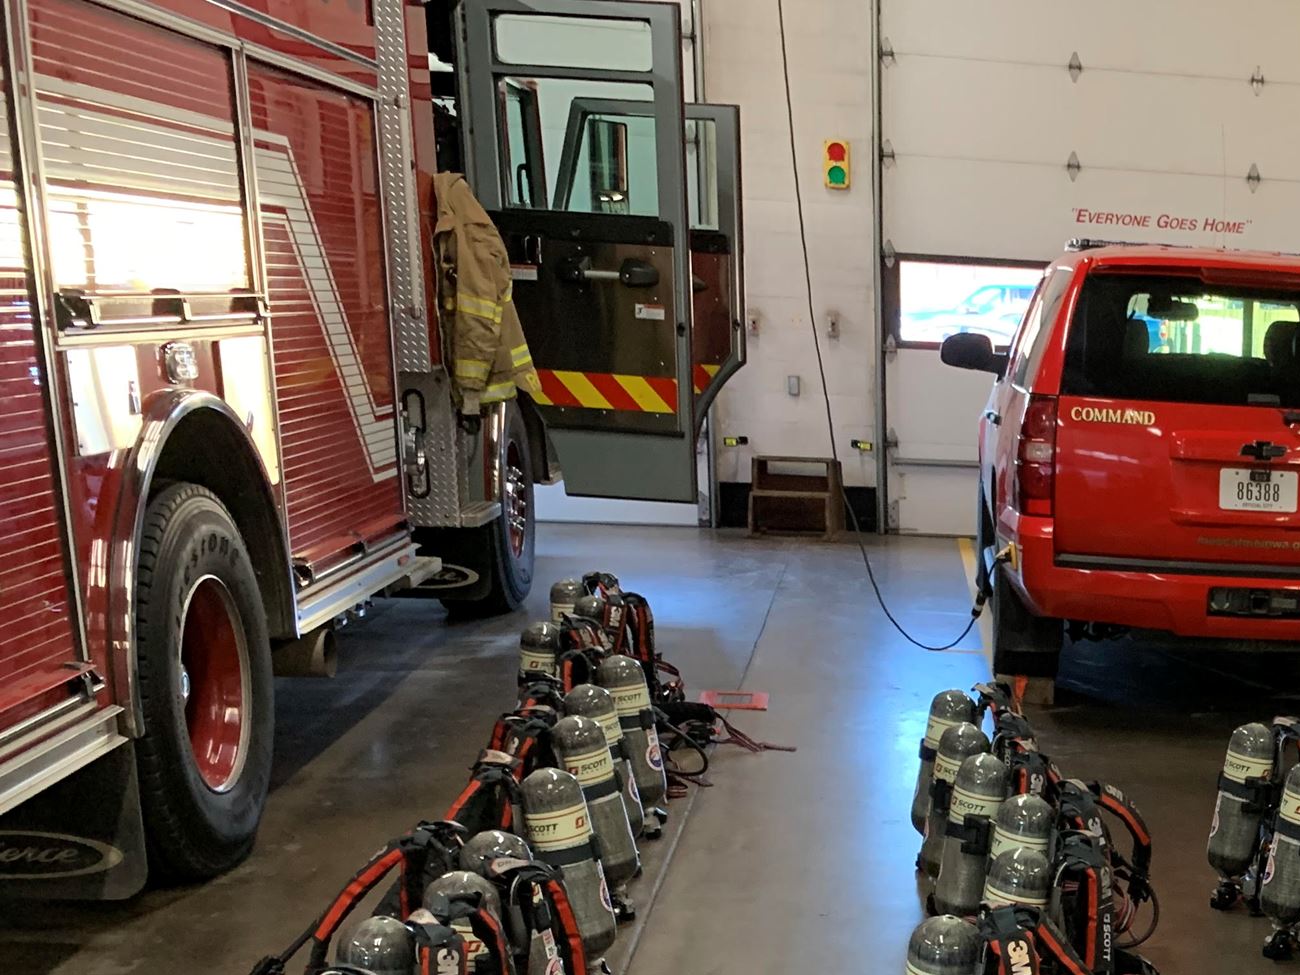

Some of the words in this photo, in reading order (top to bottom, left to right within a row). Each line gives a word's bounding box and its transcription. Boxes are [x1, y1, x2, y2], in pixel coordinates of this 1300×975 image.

[1156, 214, 1198, 232] GOES
[1071, 406, 1156, 426] COMMAND
[1237, 481, 1280, 502] 86388
[617, 692, 641, 702] SCOTT
[580, 757, 607, 773] SCOTT
[1228, 761, 1251, 773] SCOTT
[958, 800, 986, 812] SCOTT
[1103, 924, 1112, 962] SCOTT
